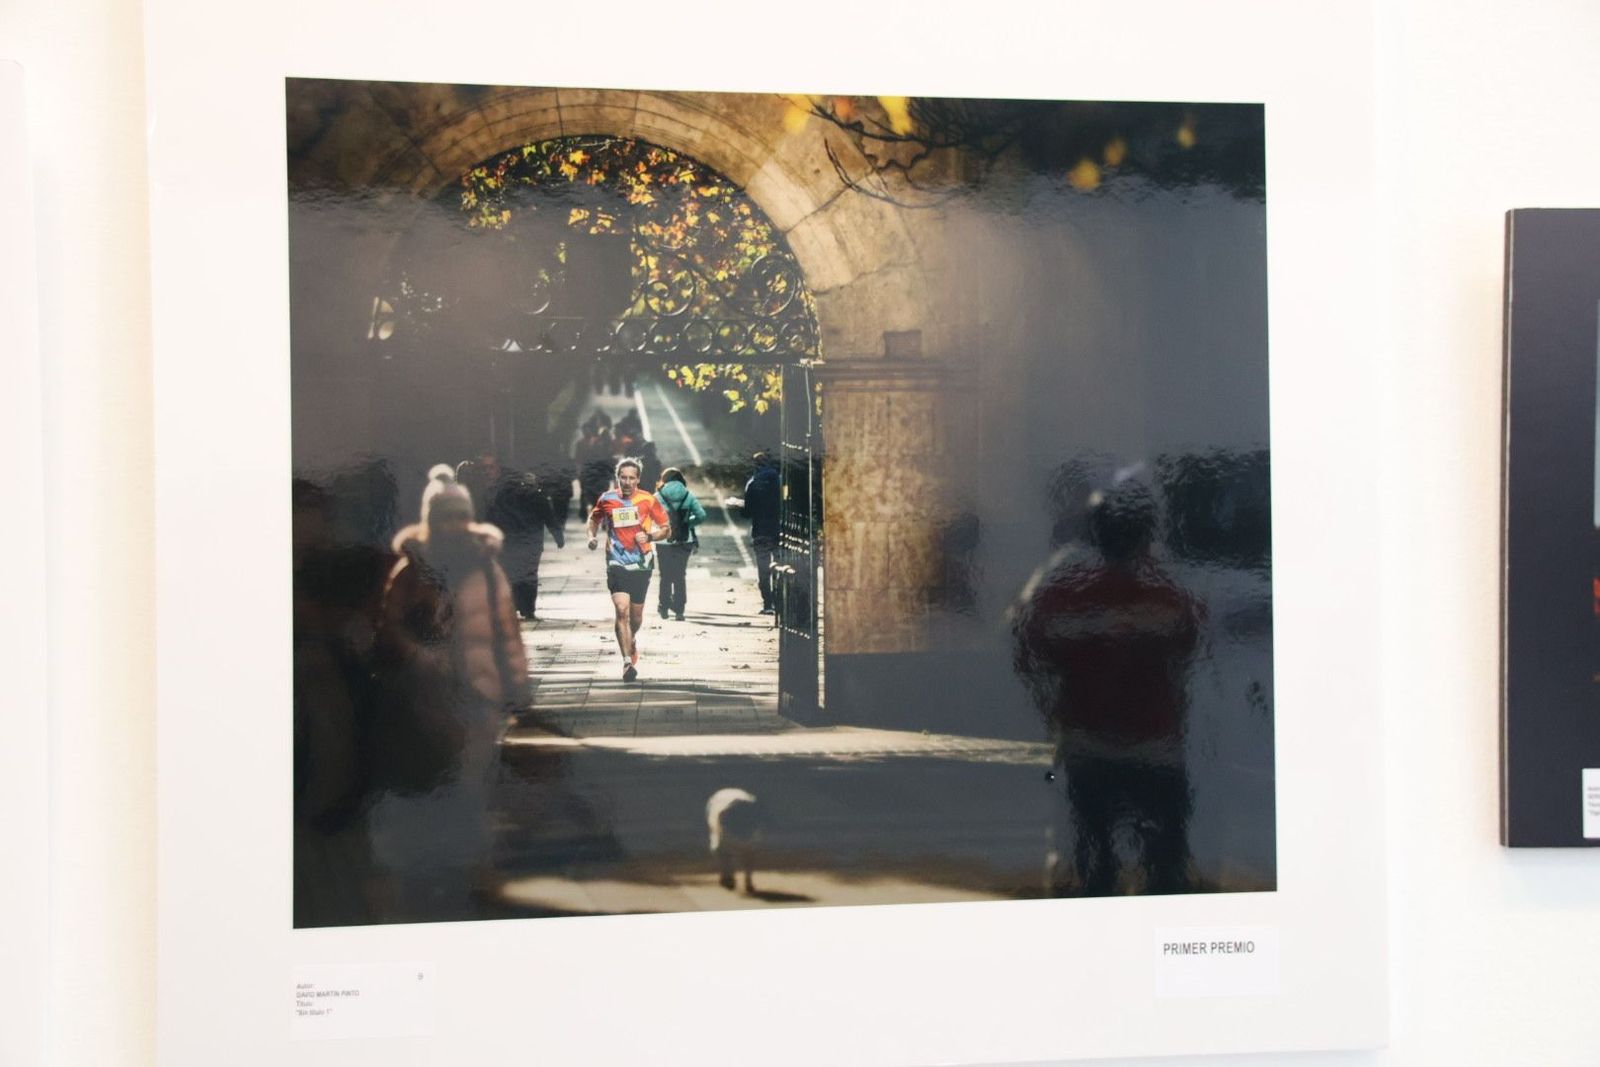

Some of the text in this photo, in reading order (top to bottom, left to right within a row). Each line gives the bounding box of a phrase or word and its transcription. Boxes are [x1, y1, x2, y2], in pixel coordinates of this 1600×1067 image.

[1163, 940, 1256, 956] PRIMER PREMIO
[296, 991, 315, 999] DAVID
